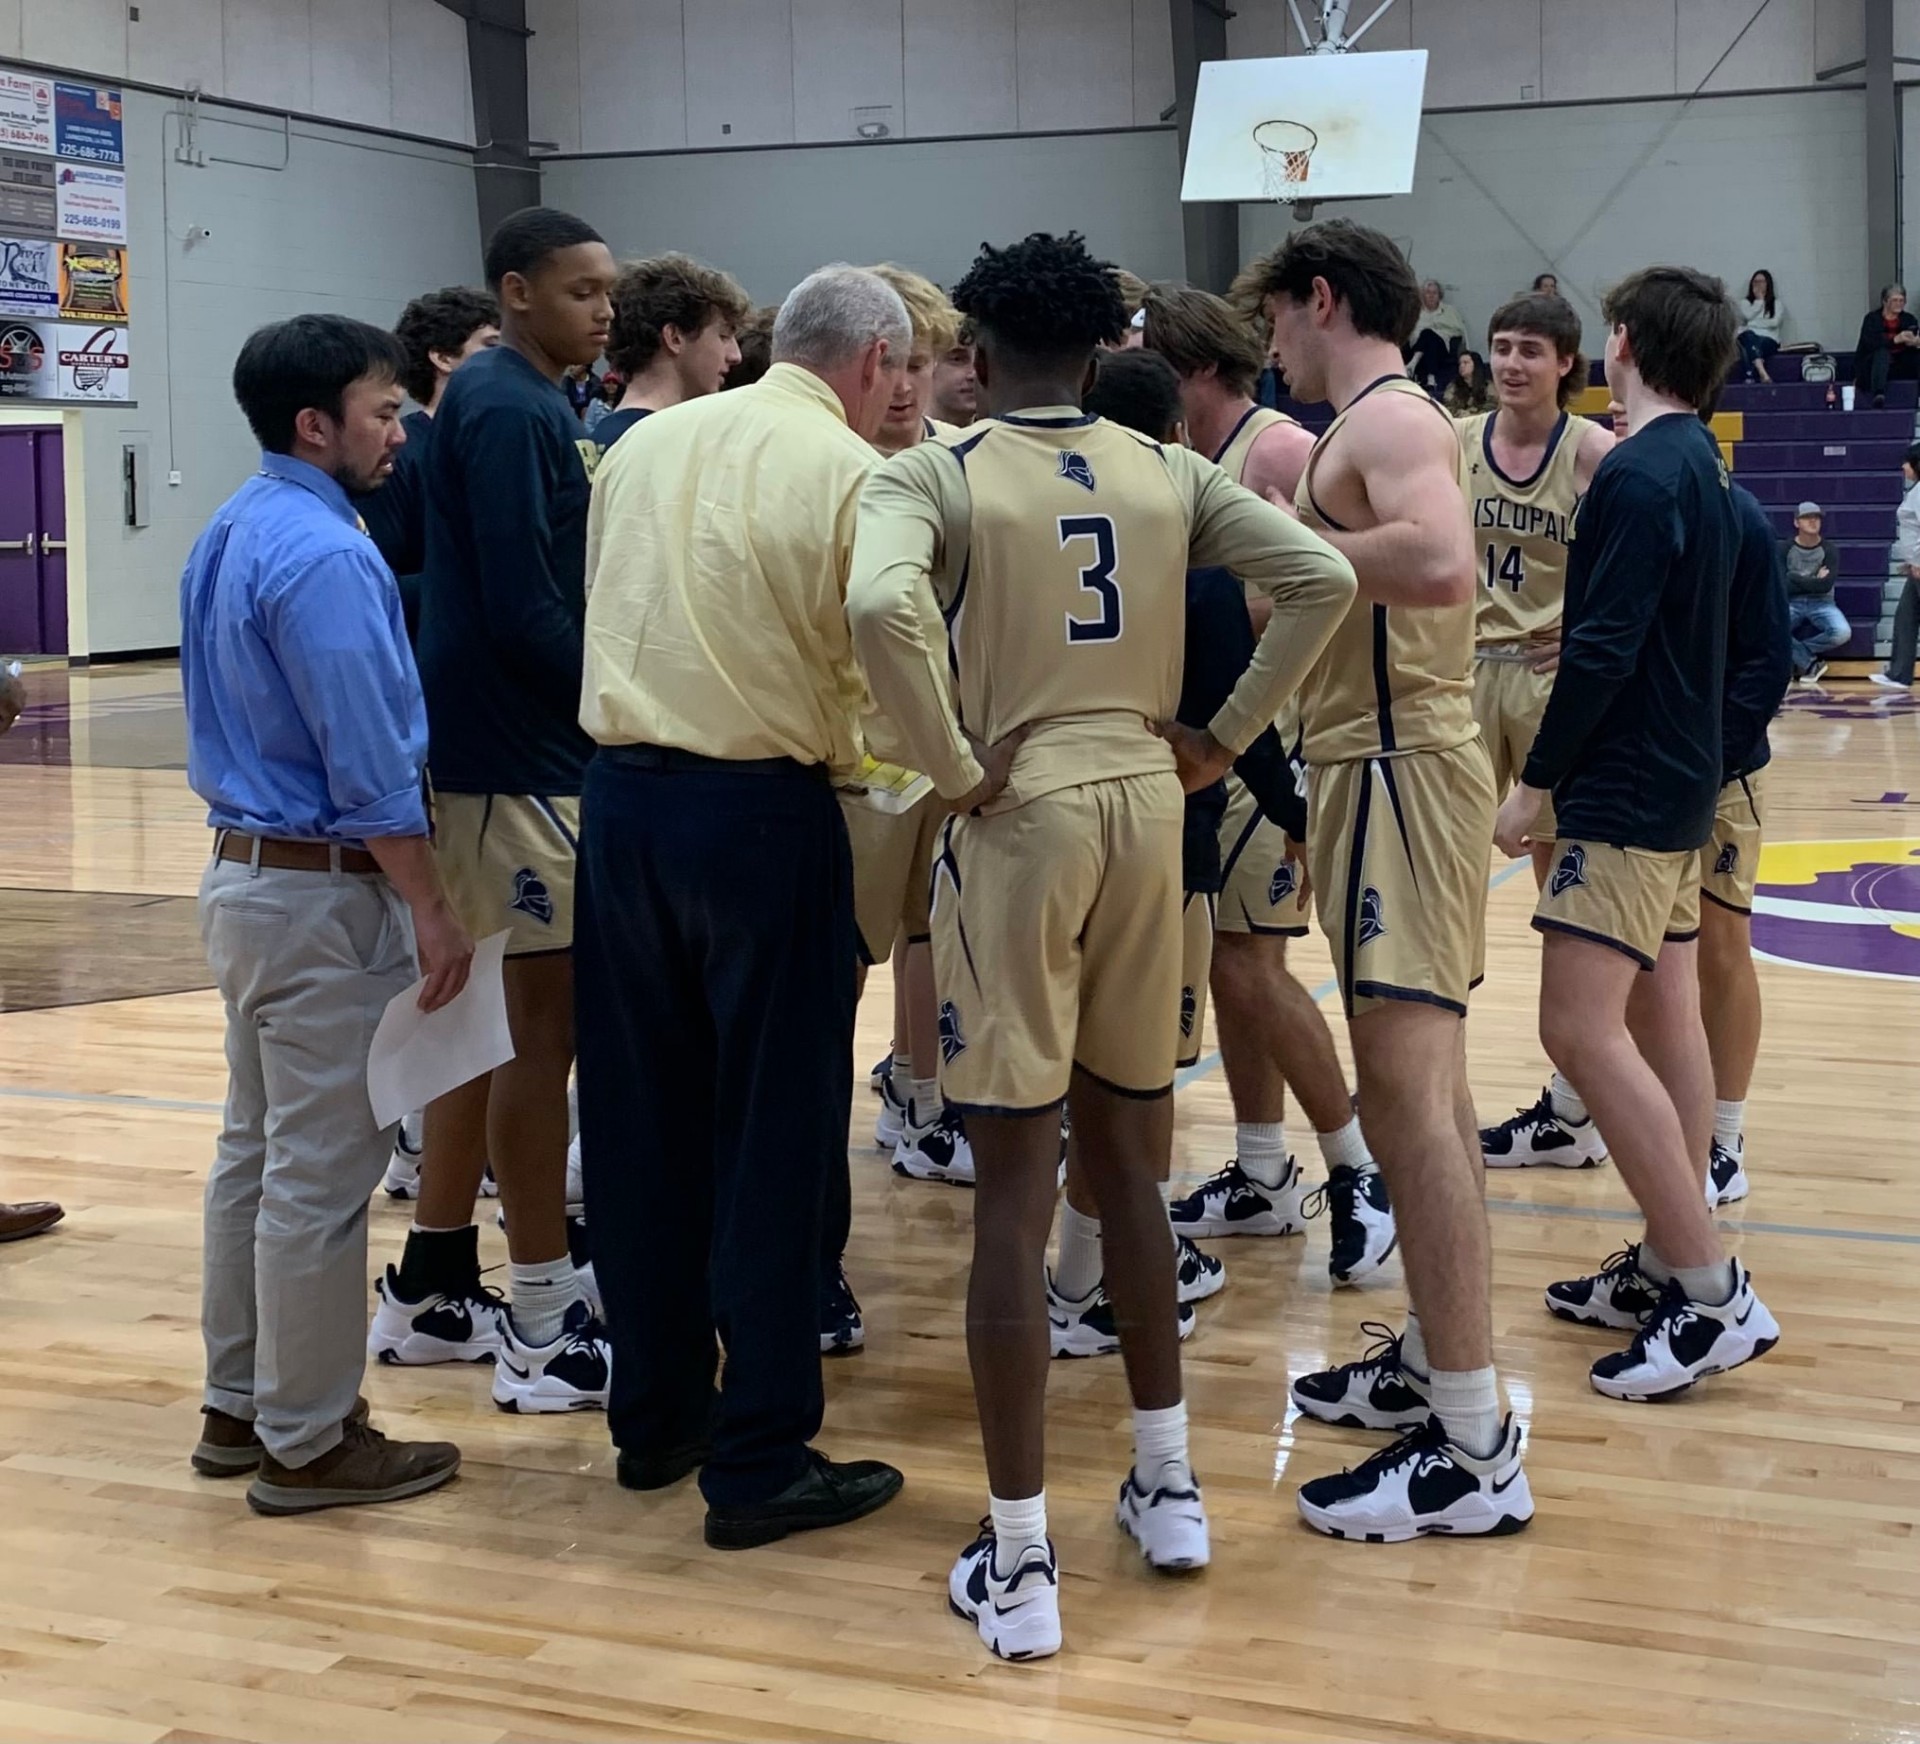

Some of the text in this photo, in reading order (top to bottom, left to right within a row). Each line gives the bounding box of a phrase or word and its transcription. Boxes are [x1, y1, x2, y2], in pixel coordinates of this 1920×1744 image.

[8, 75, 31, 90] Farm
[61, 353, 125, 365] CARTER'S
[1056, 513, 1123, 645] 3
[1485, 543, 1525, 593] 14
